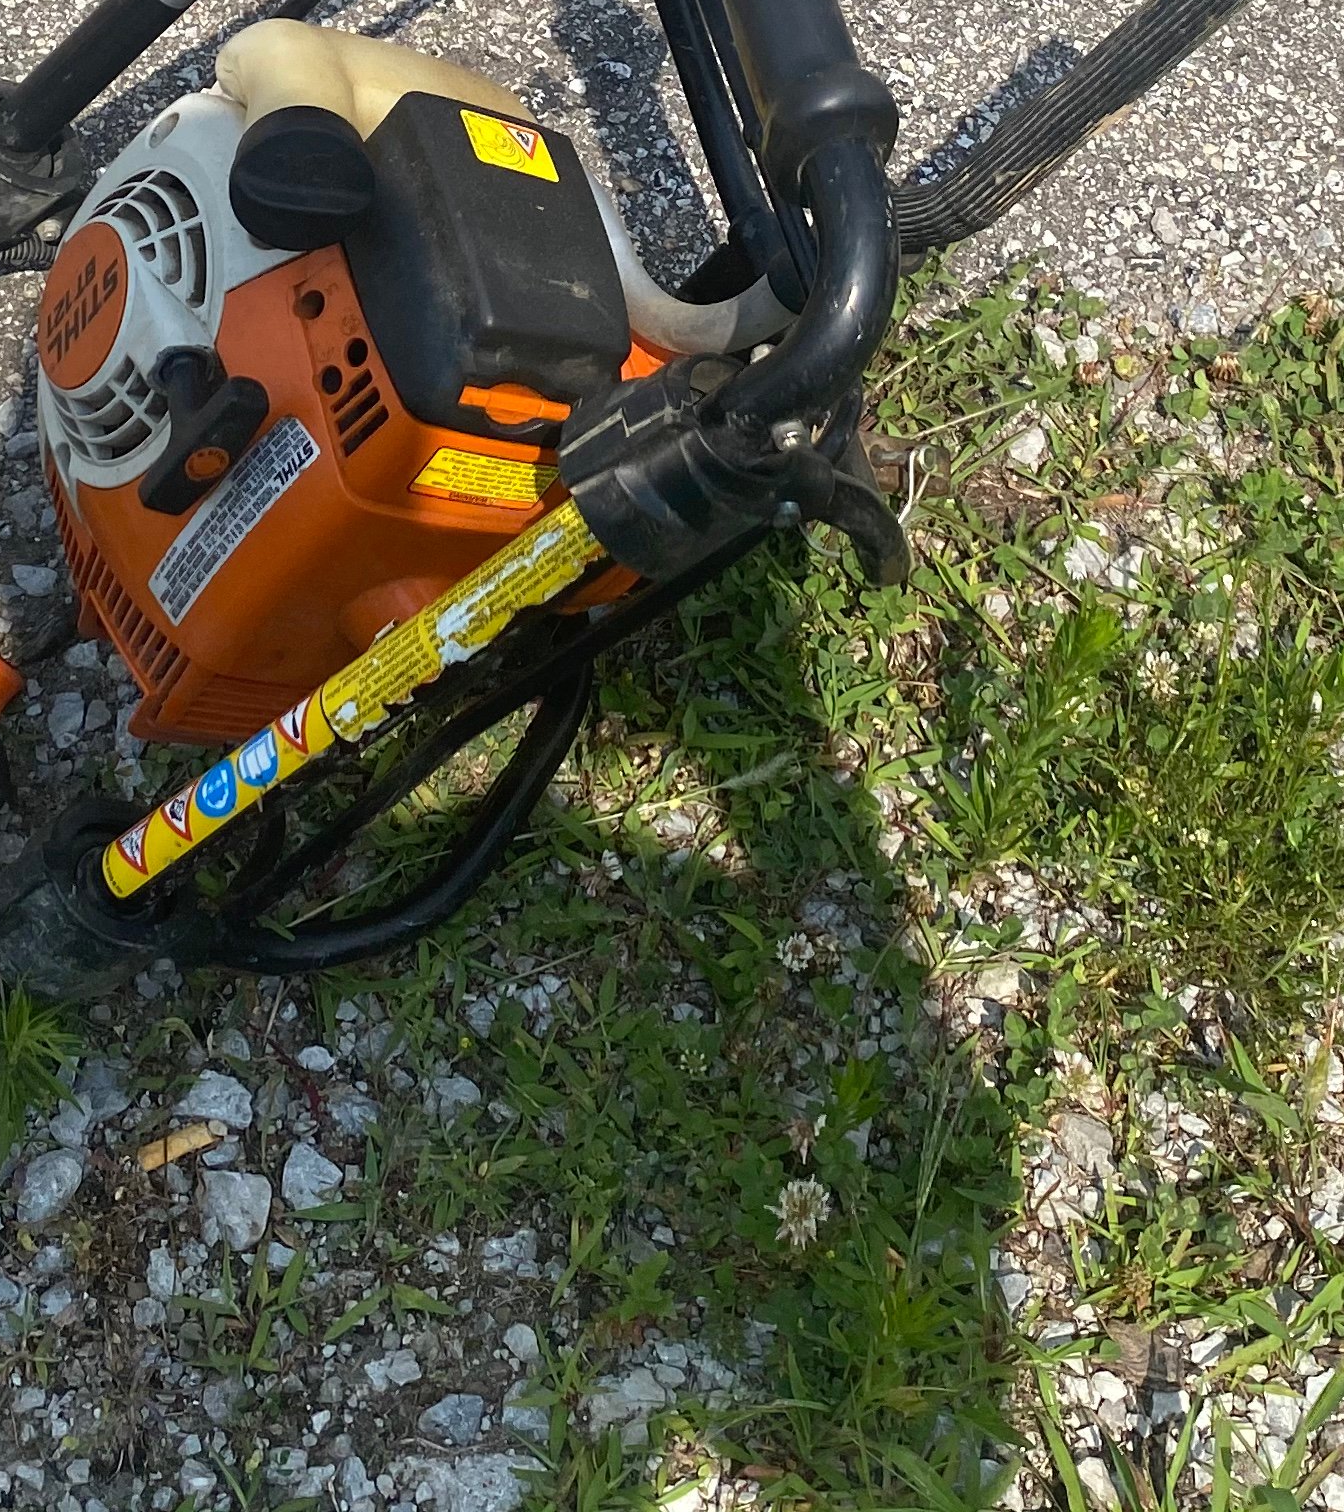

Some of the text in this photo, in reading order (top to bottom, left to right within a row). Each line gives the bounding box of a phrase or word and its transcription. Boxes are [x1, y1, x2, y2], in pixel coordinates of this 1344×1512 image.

[46, 259, 118, 363] STIHL
[47, 256, 96, 338] BT 121
[273, 440, 315, 487] STIHL
